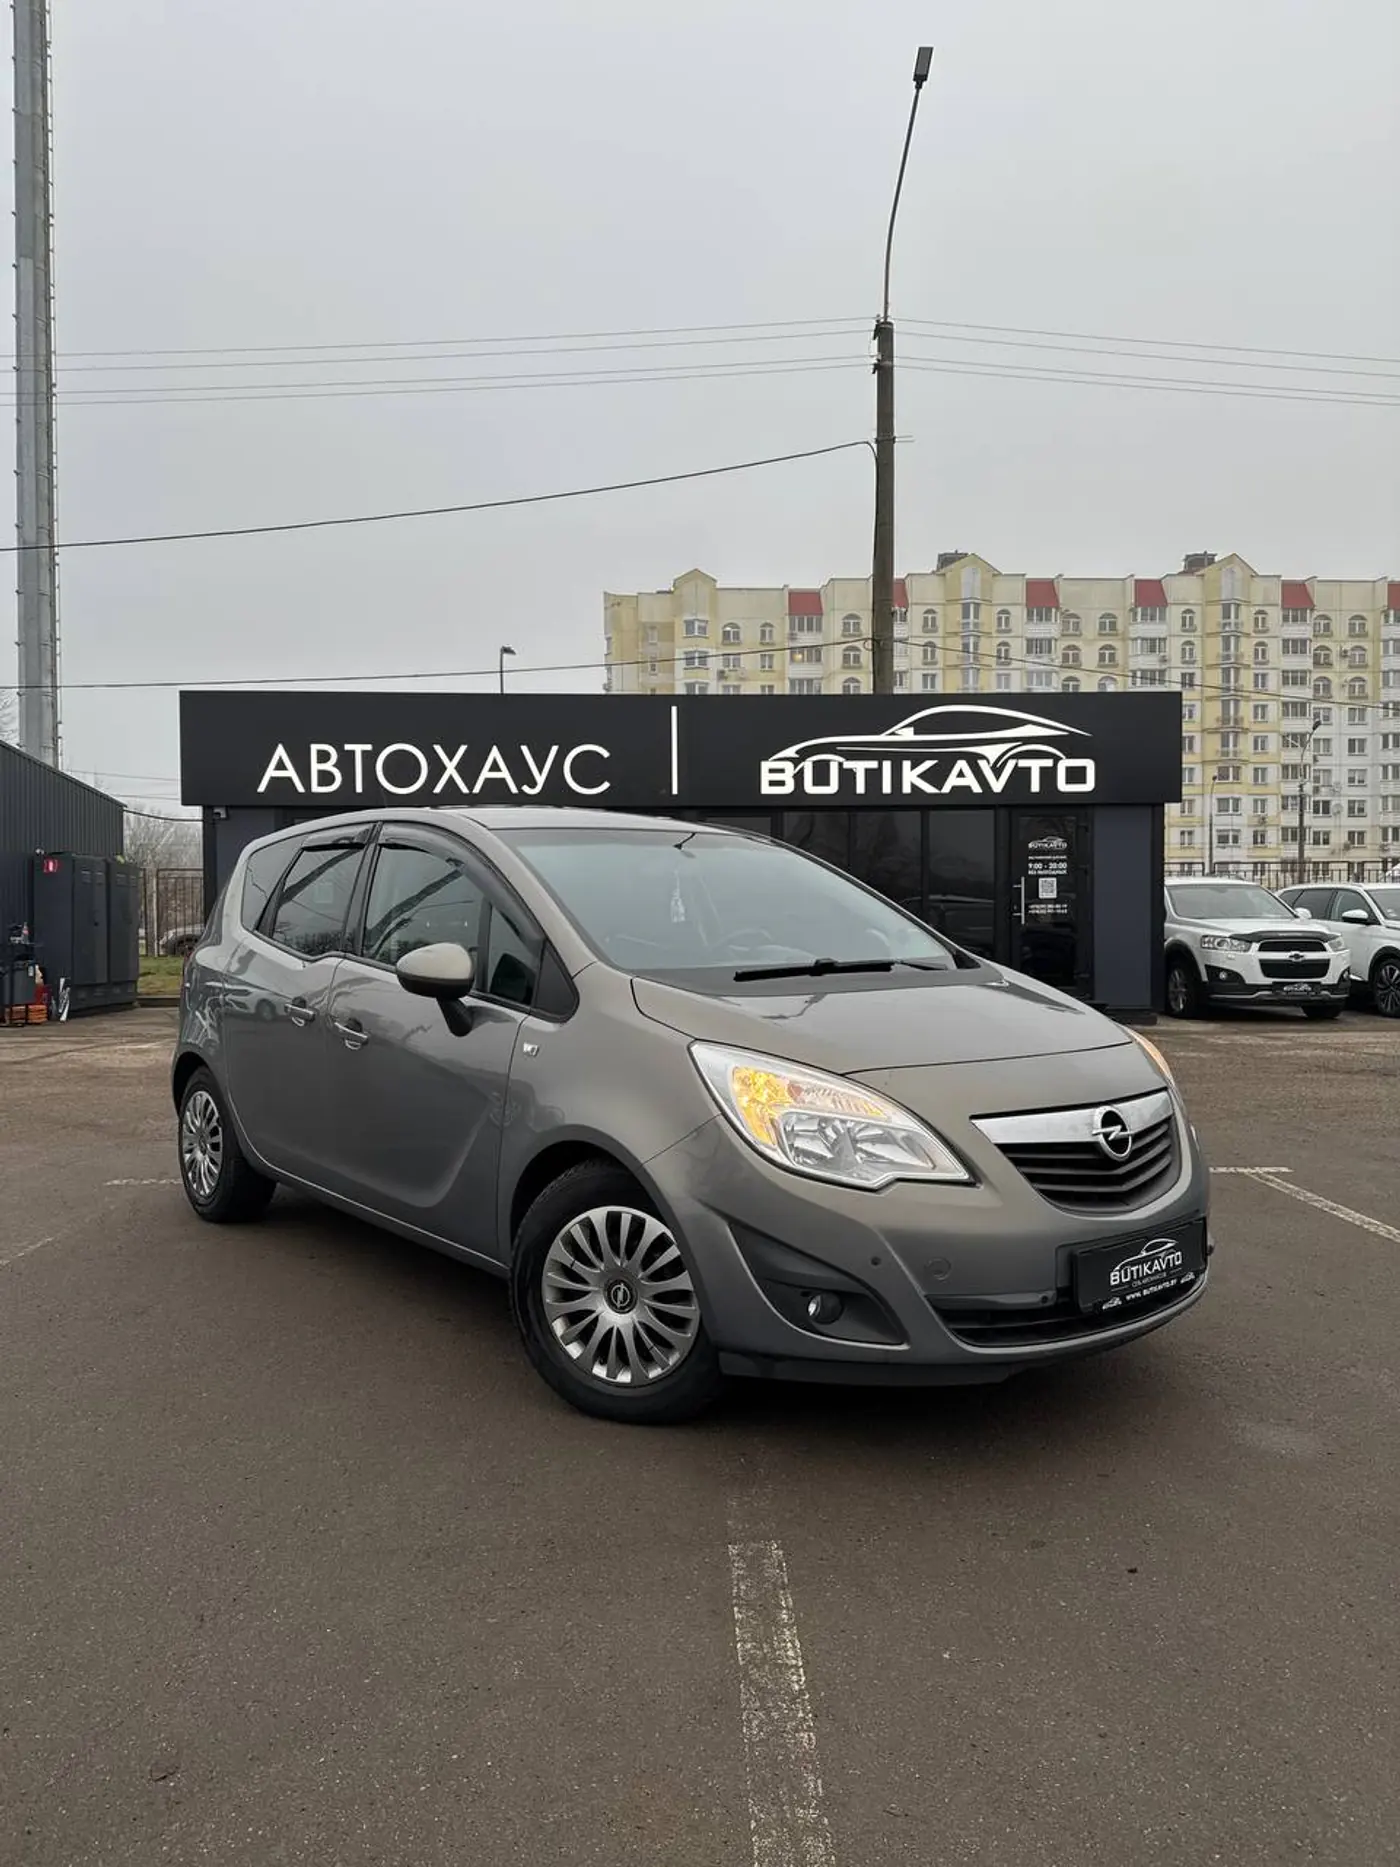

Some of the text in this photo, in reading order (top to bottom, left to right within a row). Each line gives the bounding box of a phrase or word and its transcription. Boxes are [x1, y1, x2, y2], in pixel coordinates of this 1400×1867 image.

[257, 743, 612, 795] АВТОХАУС
[760, 758, 1096, 795] BUTIKAVTO
[1110, 1251, 1183, 1286] BUTIKAVTO
